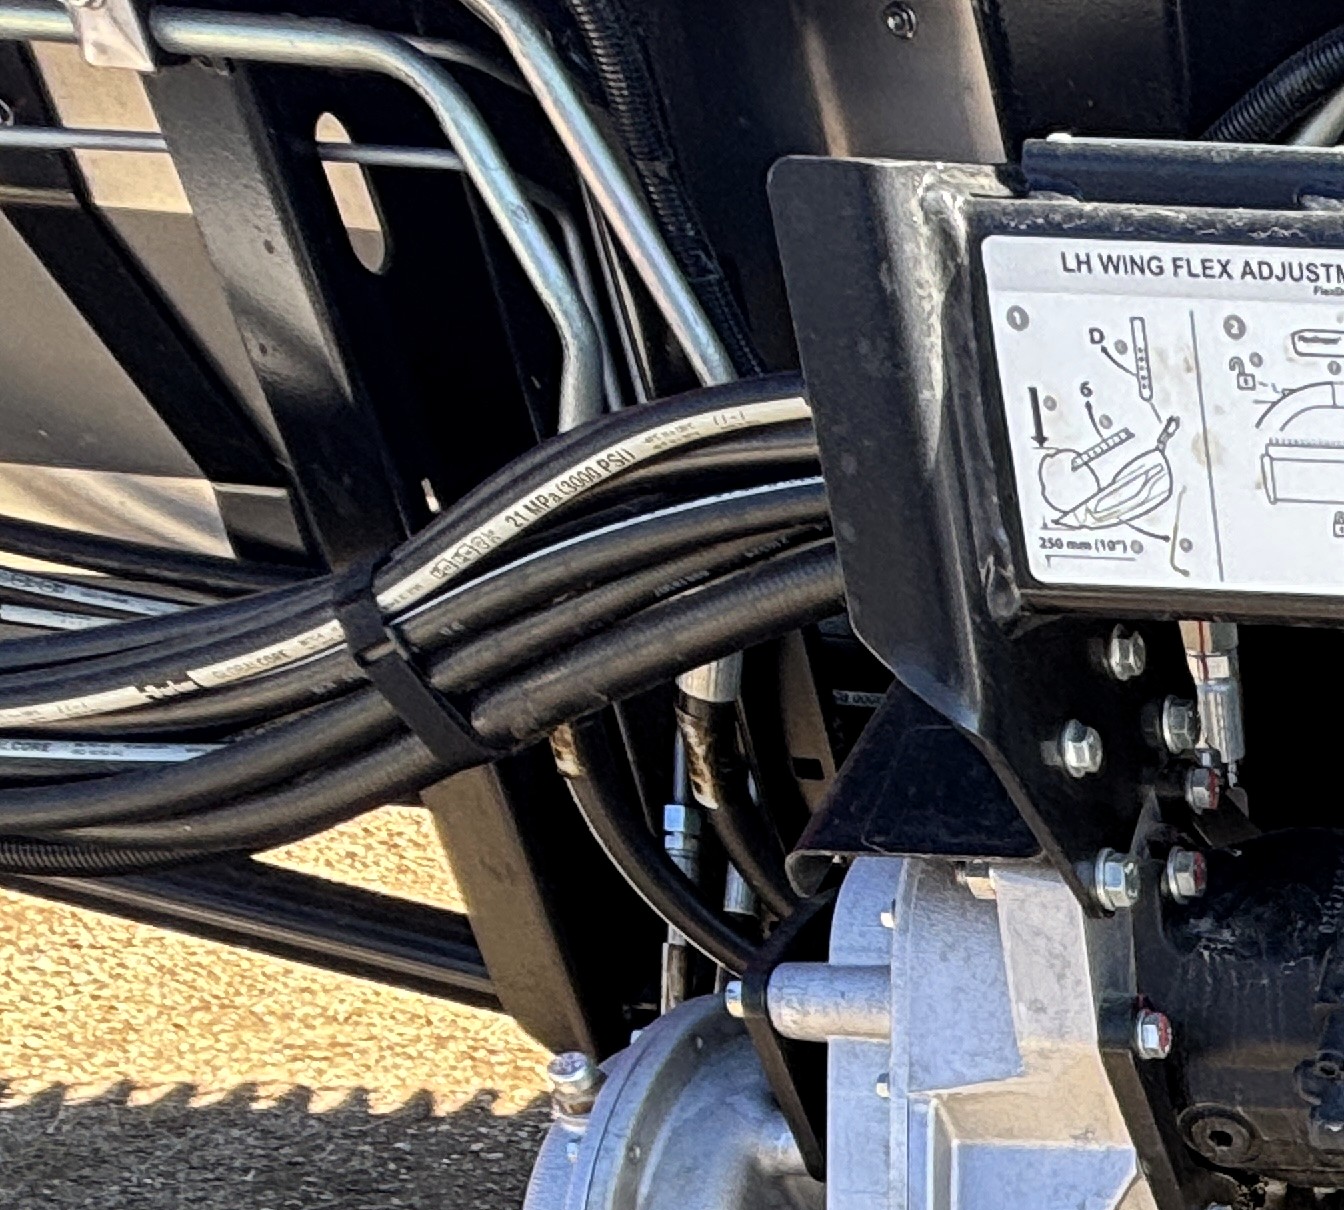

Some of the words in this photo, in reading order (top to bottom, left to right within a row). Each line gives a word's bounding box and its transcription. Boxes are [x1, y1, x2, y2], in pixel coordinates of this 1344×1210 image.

[1061, 250, 1093, 275] LH
[1098, 253, 1165, 277] WING
[1172, 257, 1235, 281] FLEX
[1089, 327, 1105, 345] D
[1080, 380, 1093, 398] 6
[505, 509, 525, 528] 21
[525, 490, 562, 522] MPa
[1038, 536, 1064, 550] 250
[1066, 540, 1092, 550] mm
